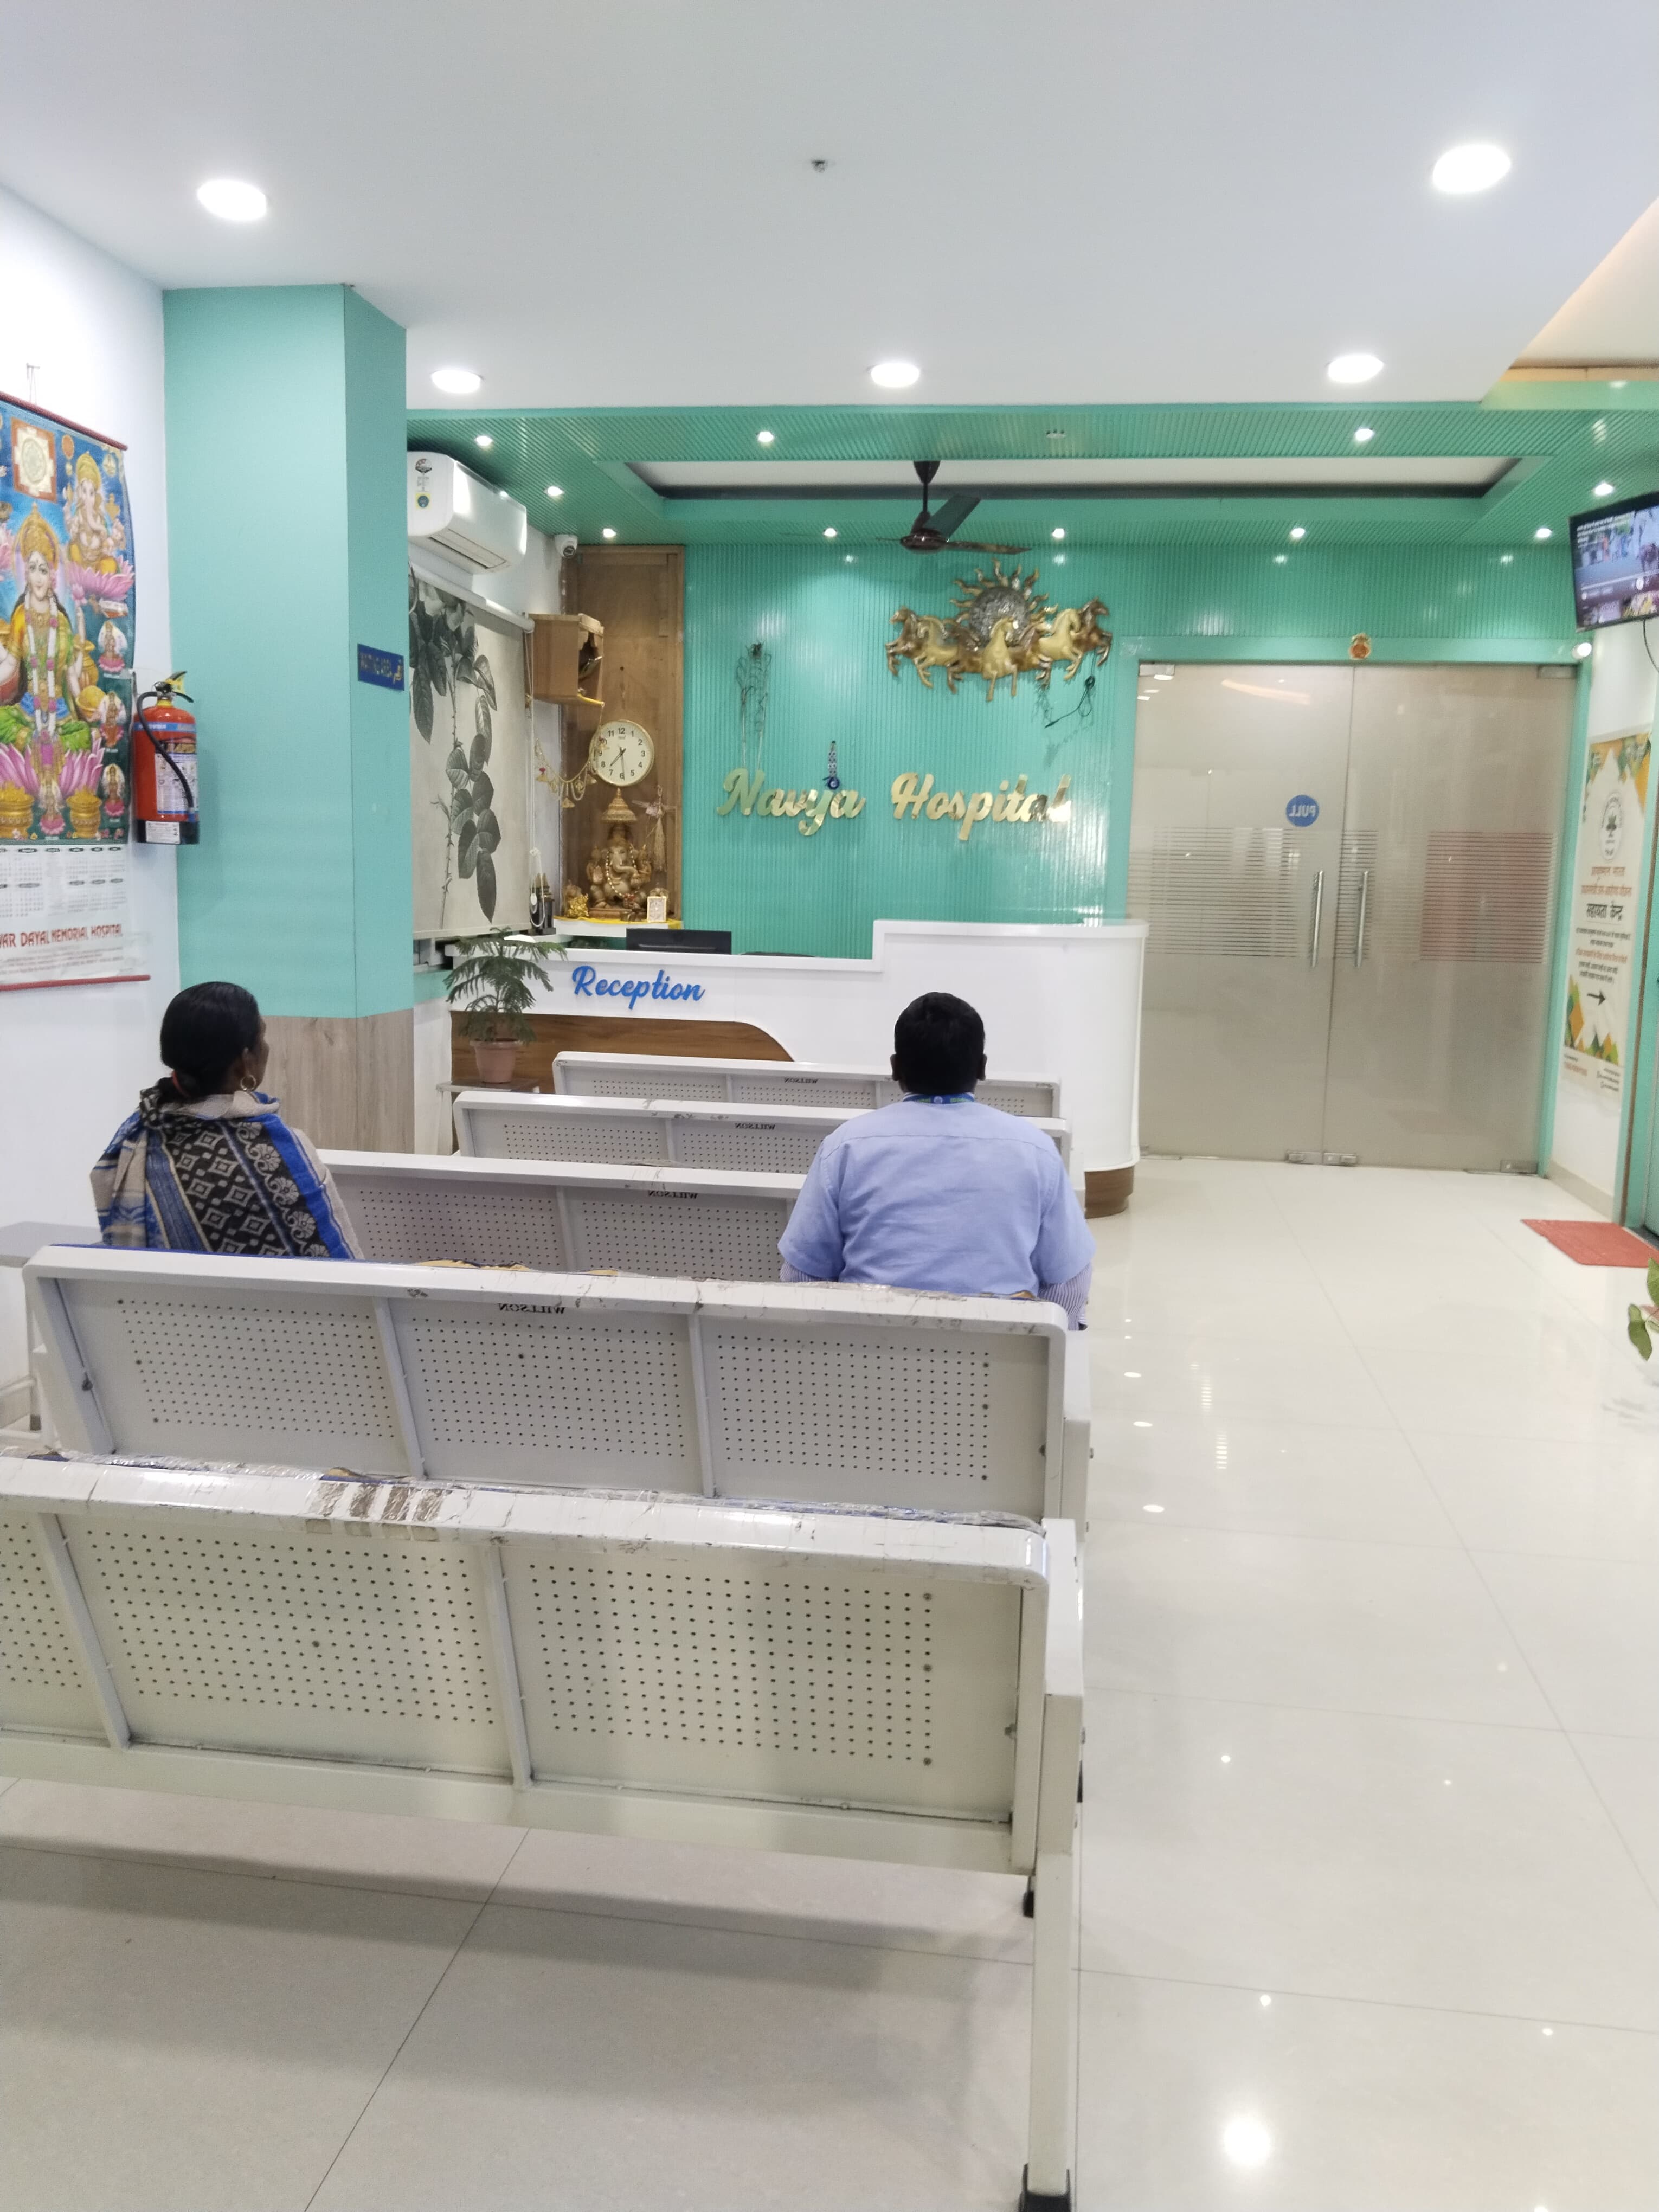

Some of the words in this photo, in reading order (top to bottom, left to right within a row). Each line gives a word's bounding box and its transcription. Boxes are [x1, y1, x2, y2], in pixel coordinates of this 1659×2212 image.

[717, 767, 866, 836] Navya
[891, 772, 1072, 841] Hospital
[21, 930, 49, 947] DAYAL
[572, 966, 705, 1010] Reception
